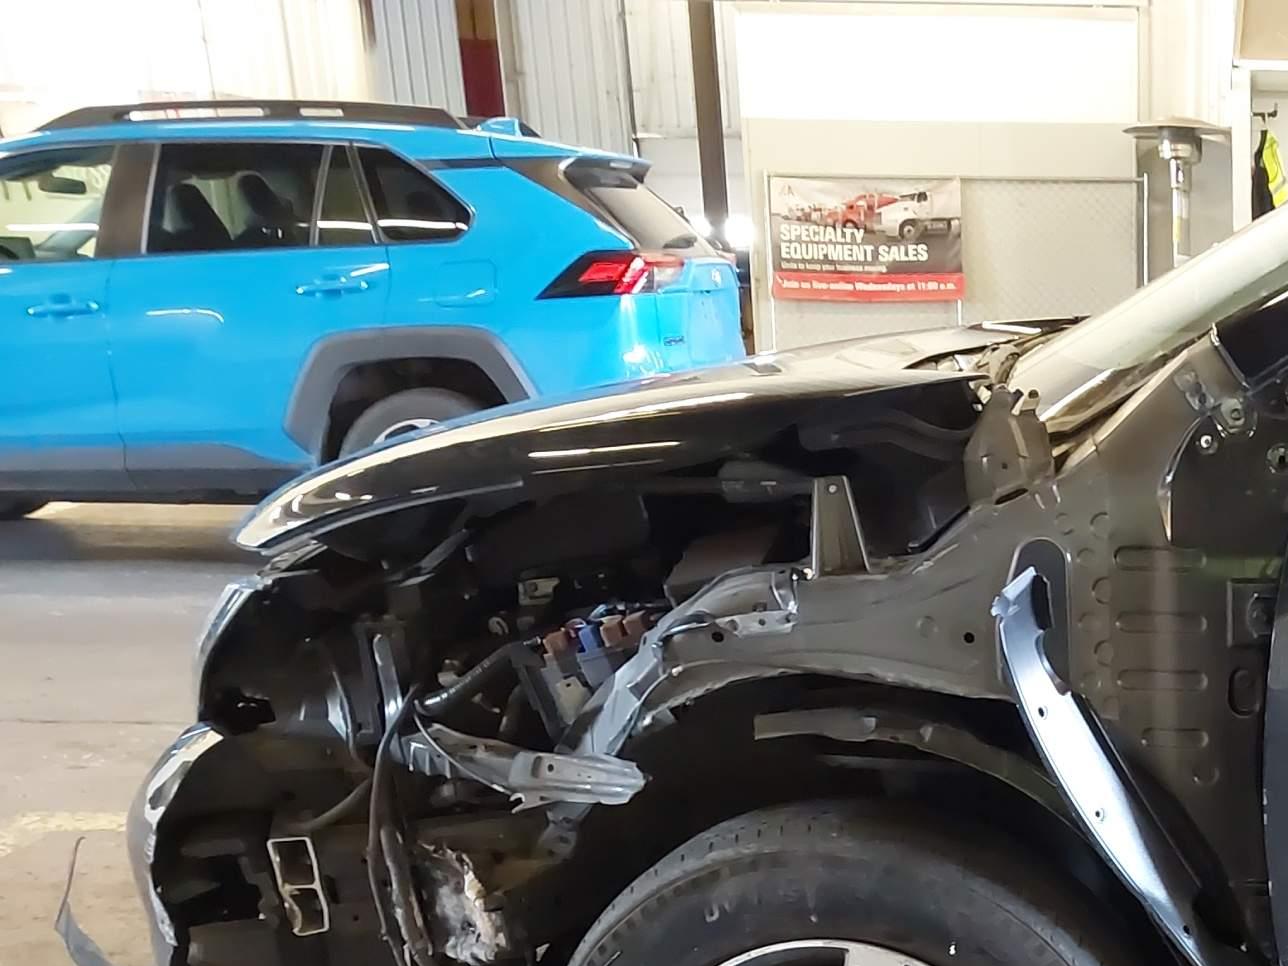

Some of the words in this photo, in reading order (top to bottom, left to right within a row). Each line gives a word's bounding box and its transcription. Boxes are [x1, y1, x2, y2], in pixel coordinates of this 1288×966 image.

[780, 223, 865, 243] SPECIALTY
[780, 242, 874, 262] EQUIPMENT
[878, 244, 929, 262] SALES
